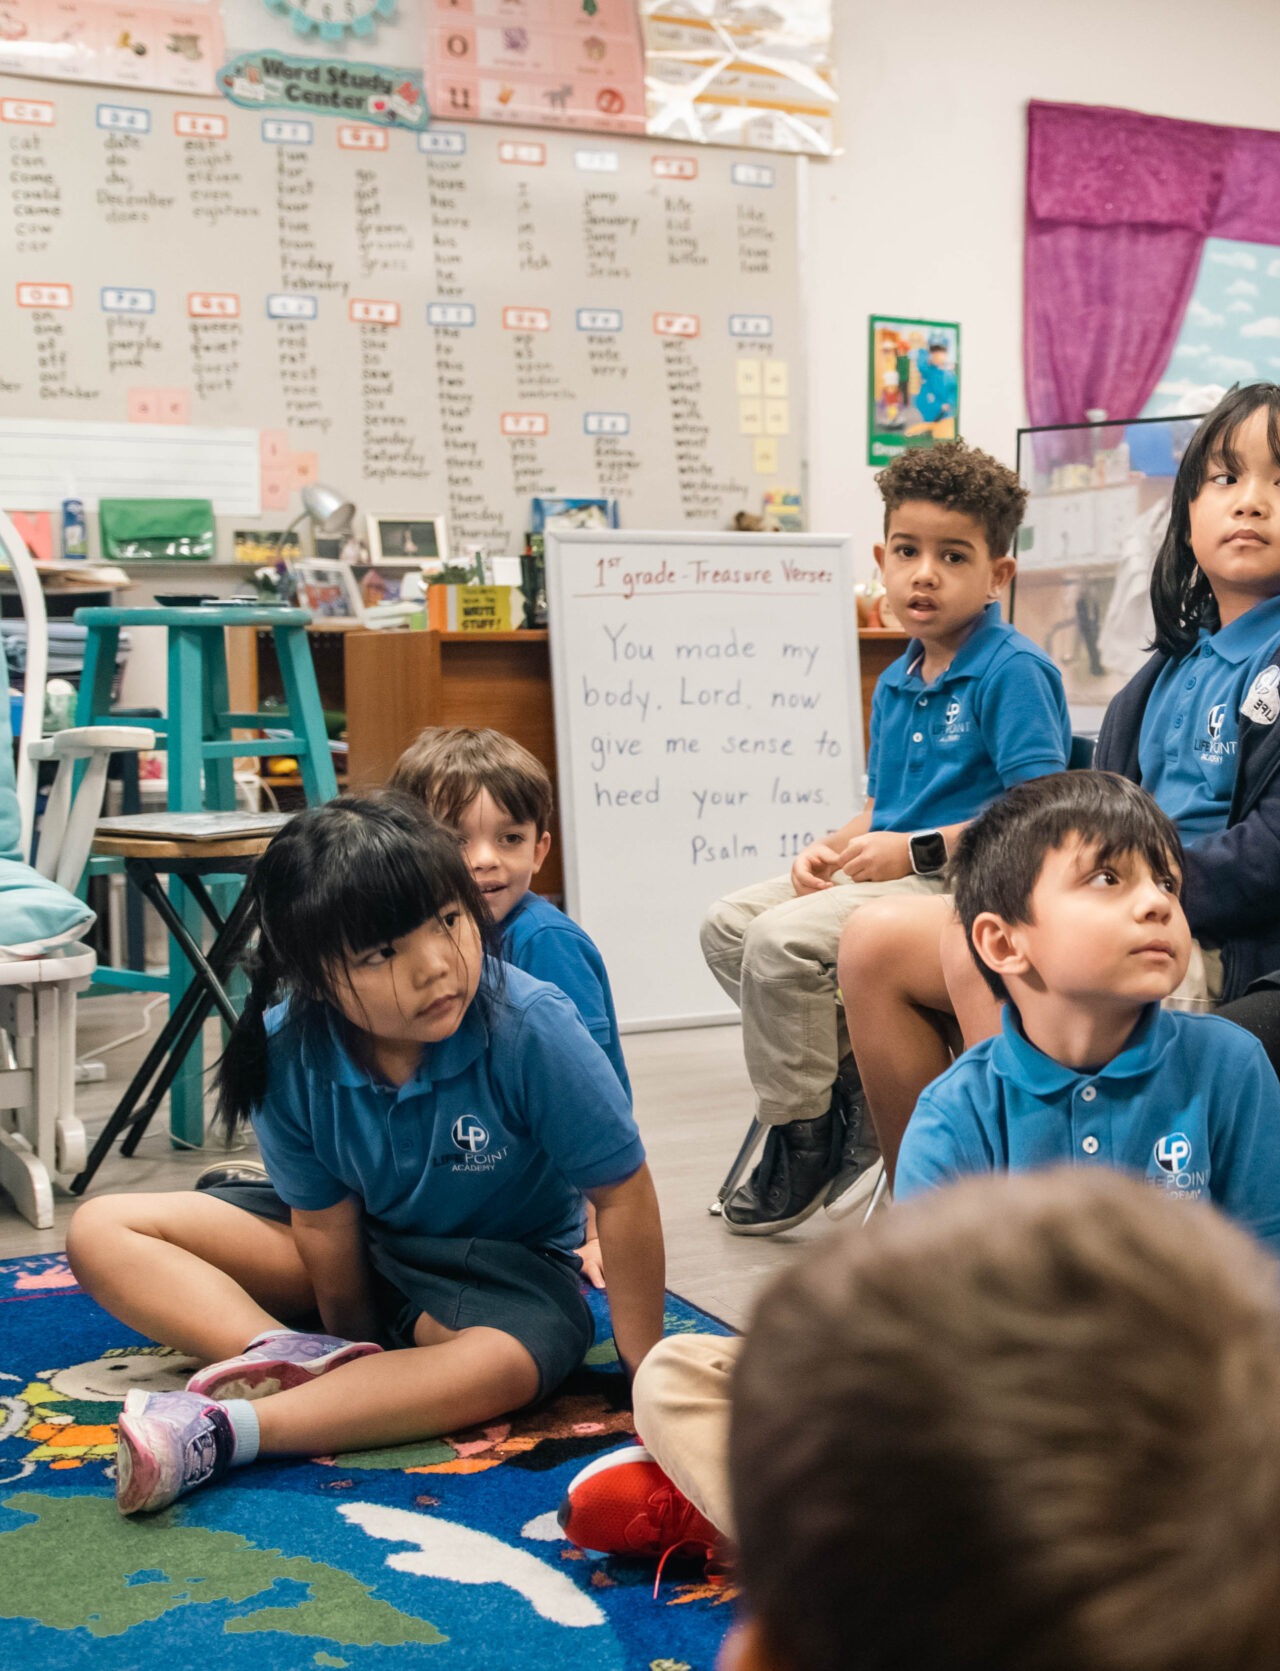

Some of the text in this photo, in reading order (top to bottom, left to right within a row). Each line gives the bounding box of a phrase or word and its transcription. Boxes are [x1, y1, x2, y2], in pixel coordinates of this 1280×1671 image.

[262, 57, 393, 95] Word Study
[285, 84, 367, 108] Center
[462, 618, 502, 631] STUFF!
[463, 606, 496, 617] WRITE
[603, 623, 820, 676] You made my
[771, 690, 821, 710] now
[591, 730, 843, 772] give me sense to
[595, 776, 660, 807] heed
[692, 790, 750, 819] your
[691, 835, 759, 866] Psalm
[452, 1164, 496, 1172] ACADEMY
